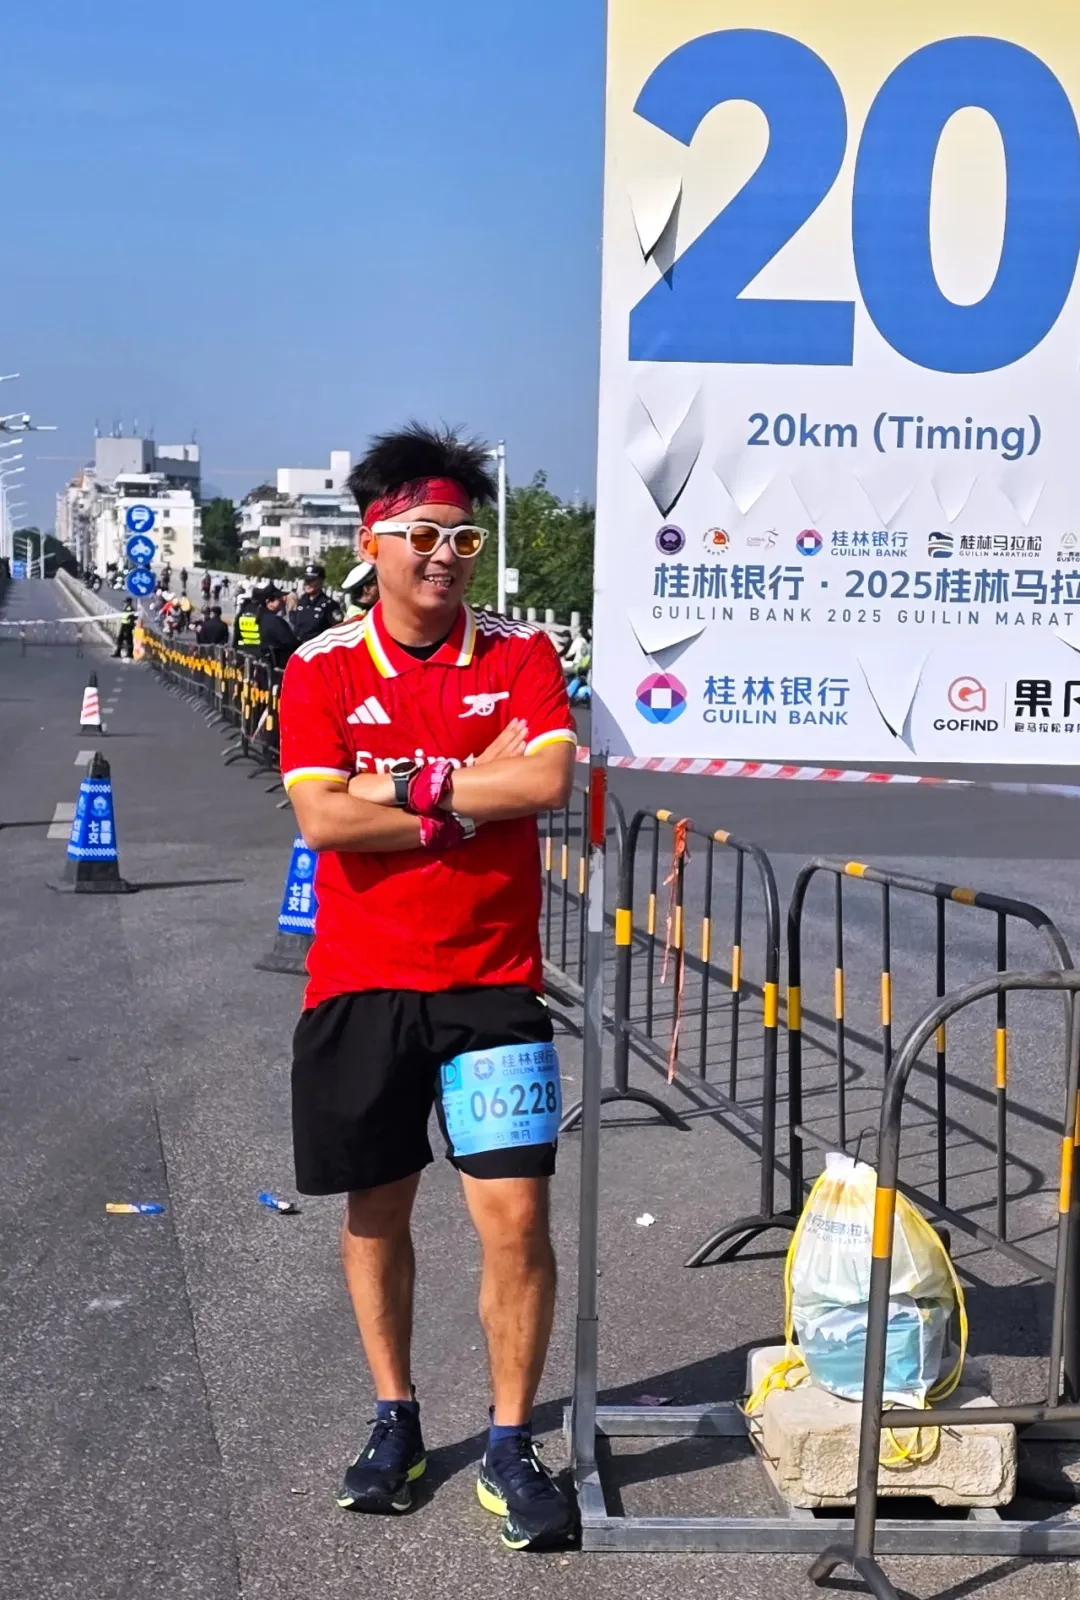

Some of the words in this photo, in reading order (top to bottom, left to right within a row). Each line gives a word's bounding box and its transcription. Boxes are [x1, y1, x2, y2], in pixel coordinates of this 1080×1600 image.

[629, 28, 1080, 374] 20
[747, 412, 858, 448] 20km
[873, 411, 1041, 461] (Timing)
[831, 530, 909, 548] 桂林银行
[960, 534, 1042, 551] 桂林马拉松
[831, 548, 870, 557] GUILIN
[876, 549, 908, 558] BANK
[652, 605, 734, 621] GUILIN
[749, 607, 812, 622] BANK
[827, 608, 882, 623] 2025
[897, 609, 980, 625] GUILIN
[995, 611, 1074, 626] MARAT
[703, 675, 850, 707] 桂林银行
[702, 709, 777, 724] GUILIN
[788, 710, 849, 726] BANK
[933, 718, 998, 732] GOFIND
[470, 1080, 557, 1122] 06228
